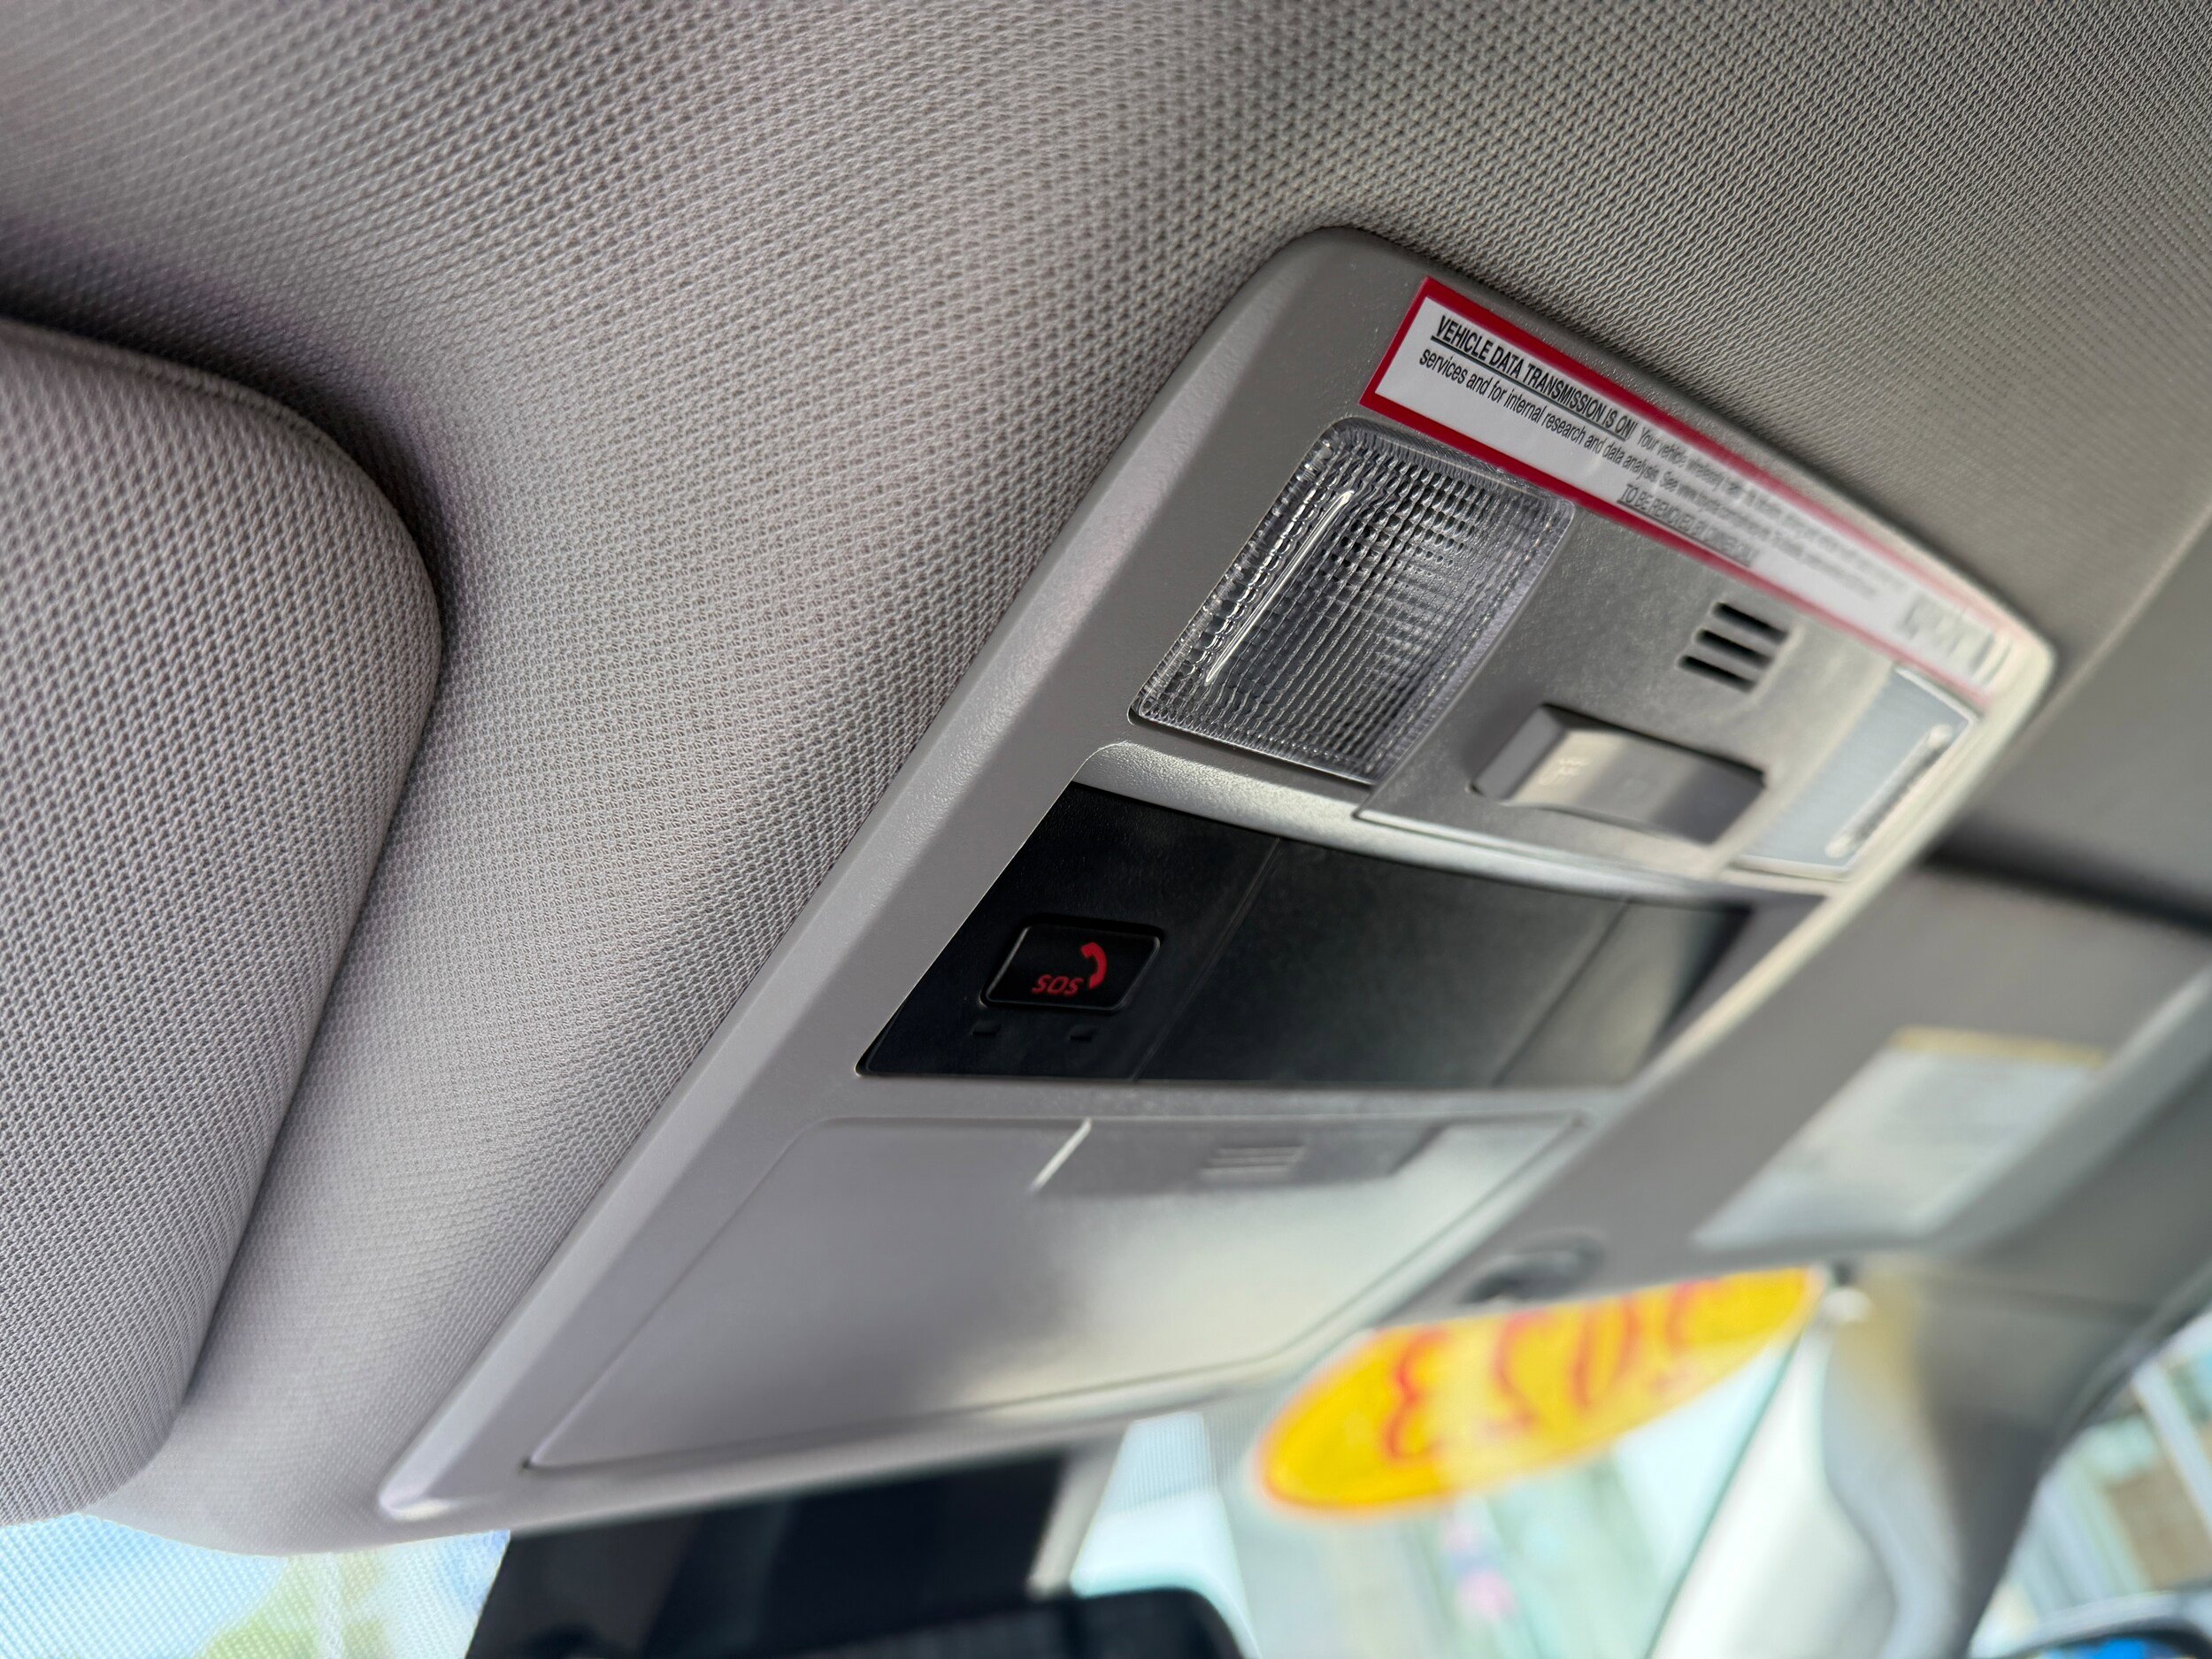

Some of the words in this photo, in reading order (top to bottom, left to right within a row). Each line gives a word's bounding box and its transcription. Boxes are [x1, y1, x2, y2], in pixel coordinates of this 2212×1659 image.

[1419, 349, 1467, 384] services
[1466, 369, 1493, 396] and
[1487, 380, 1507, 404] for
[1503, 388, 1547, 424] internal
[1541, 411, 1586, 445] research
[1584, 434, 1607, 454] and
[1602, 442, 1624, 465] data
[1658, 471, 1679, 493] See
[1436, 315, 1494, 360] VEHICLE
[1490, 346, 1525, 379] DATA
[1523, 363, 1607, 422] TRANSMISSION
[1603, 406, 1617, 429] IS
[1615, 415, 1639, 440] ON!
[1638, 426, 1660, 452] Your
[1657, 444, 1689, 467] vehicle
[1622, 483, 1639, 505] TO
[1636, 491, 1652, 511] BE
[1649, 496, 1696, 532] REMOVED
[1032, 974, 1084, 996] SOS
